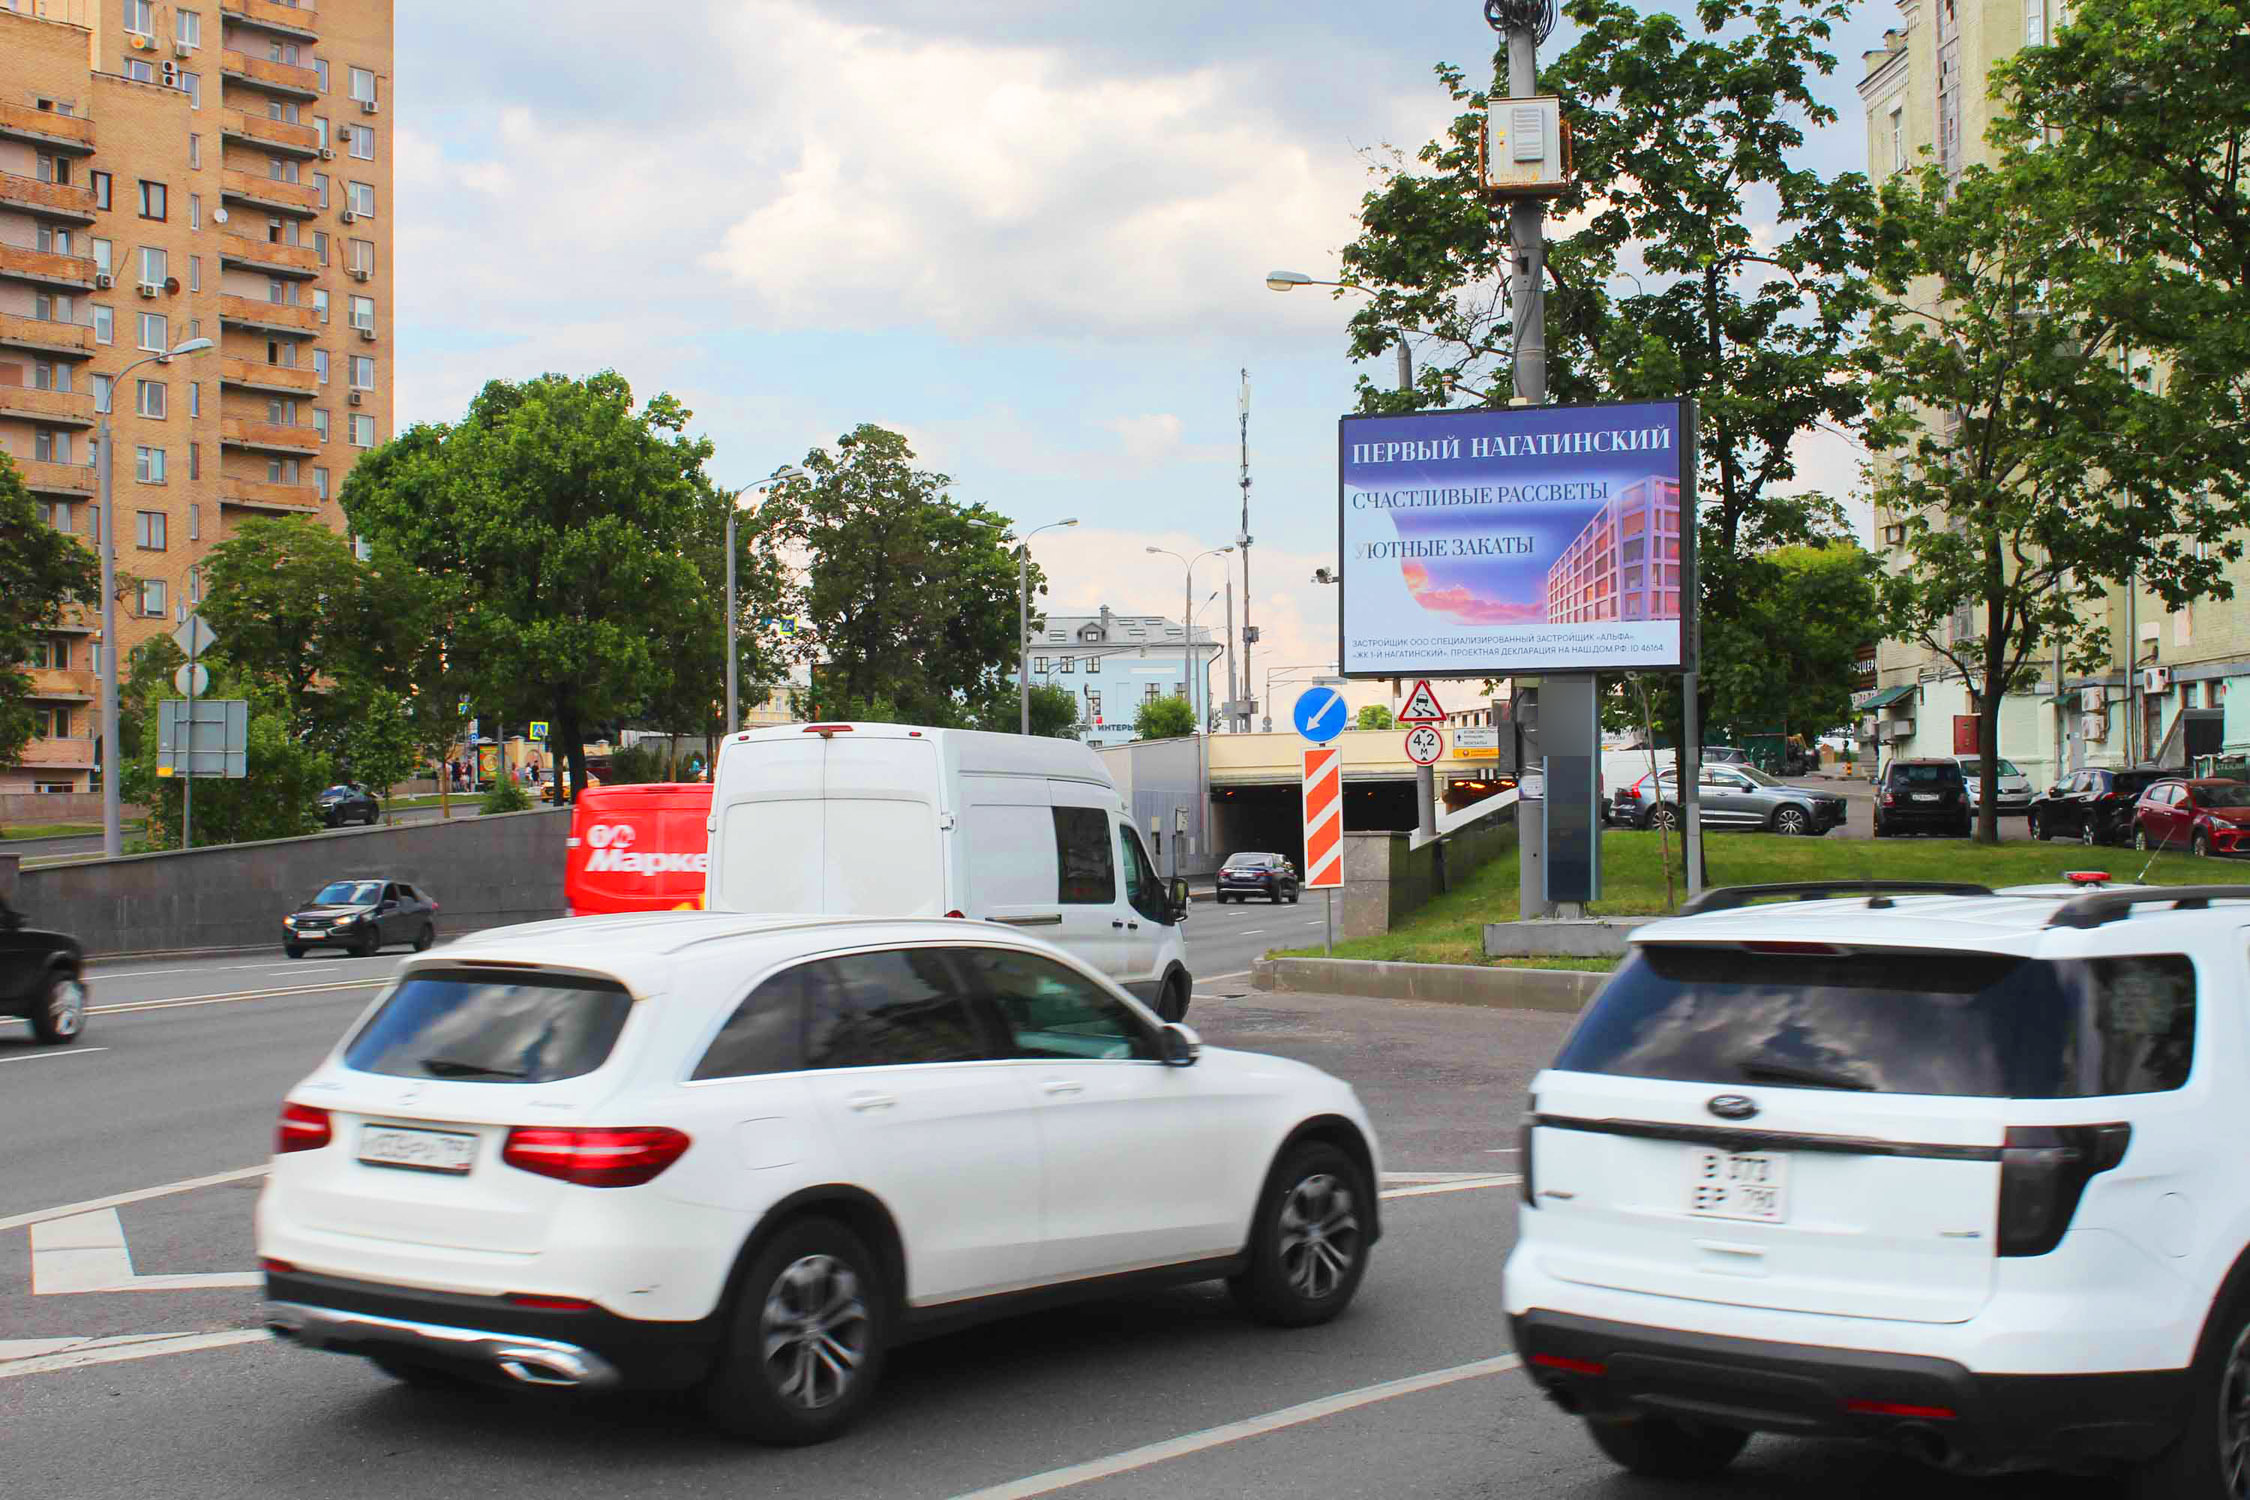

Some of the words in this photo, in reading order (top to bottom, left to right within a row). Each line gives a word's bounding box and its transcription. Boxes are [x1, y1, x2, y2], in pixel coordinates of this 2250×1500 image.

[1352, 435, 1460, 464] ПЕРВЫЙ
[1471, 423, 1671, 458] НАГАТИНСКИЙ
[1352, 485, 1493, 510] СЧАСТЛИВЫЕ
[1497, 481, 1609, 504] РАССВЕТЫ
[1354, 538, 1448, 560] УЮТНЫЕ
[1452, 535, 1535, 556] ЗАКАТЫ
[1352, 638, 1409, 648] ЗАСТРОЙЩИК
[1410, 637, 1429, 647] ООО
[1431, 634, 1535, 646] СПЕЦИАЛИЗИРОВАННЫЙ
[1536, 632, 1595, 643] ЗАСТРОЙЩИК
[1450, 646, 1500, 657] ПРОЕКТНАЯ
[1500, 645, 1556, 656] ДЕКЛАРАЦИЯ
[1558, 645, 1570, 654] НА
[1630, 644, 1639, 653] ID
[1412, 733, 1436, 748] 4,2
